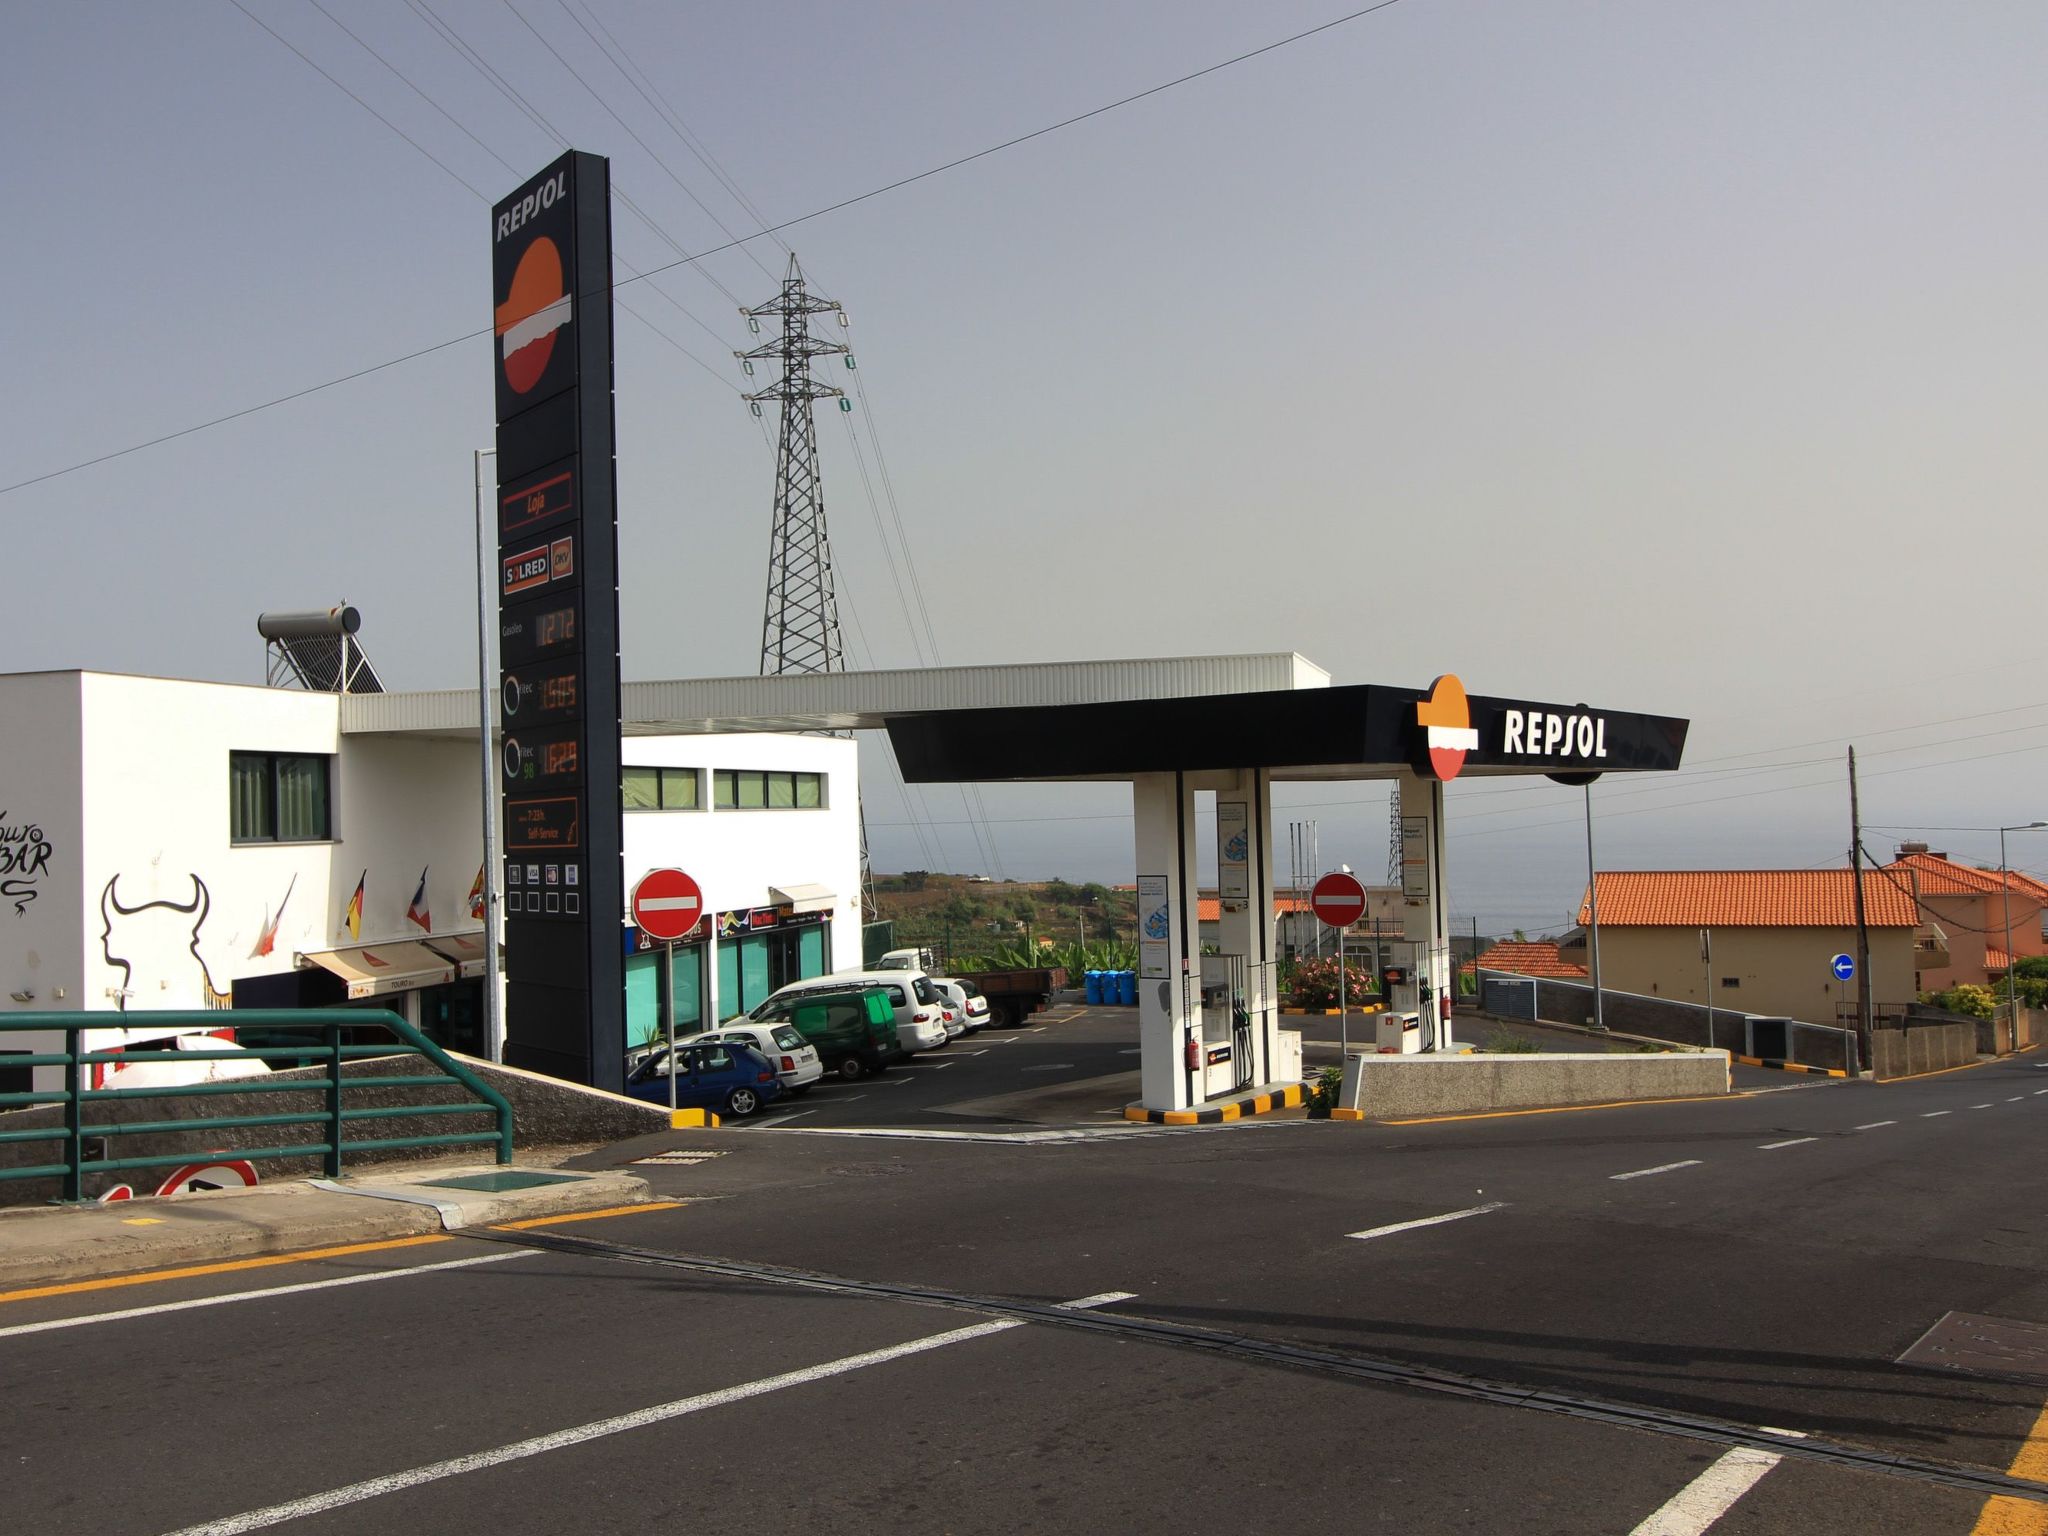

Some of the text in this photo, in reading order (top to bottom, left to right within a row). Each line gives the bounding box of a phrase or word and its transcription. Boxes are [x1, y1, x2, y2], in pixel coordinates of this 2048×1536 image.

[497, 171, 566, 242] REPSOL
[527, 492, 545, 515] Loja
[507, 558, 546, 583] SOLRED
[1504, 710, 1606, 758] REPSOL
[524, 762, 534, 780] 98
